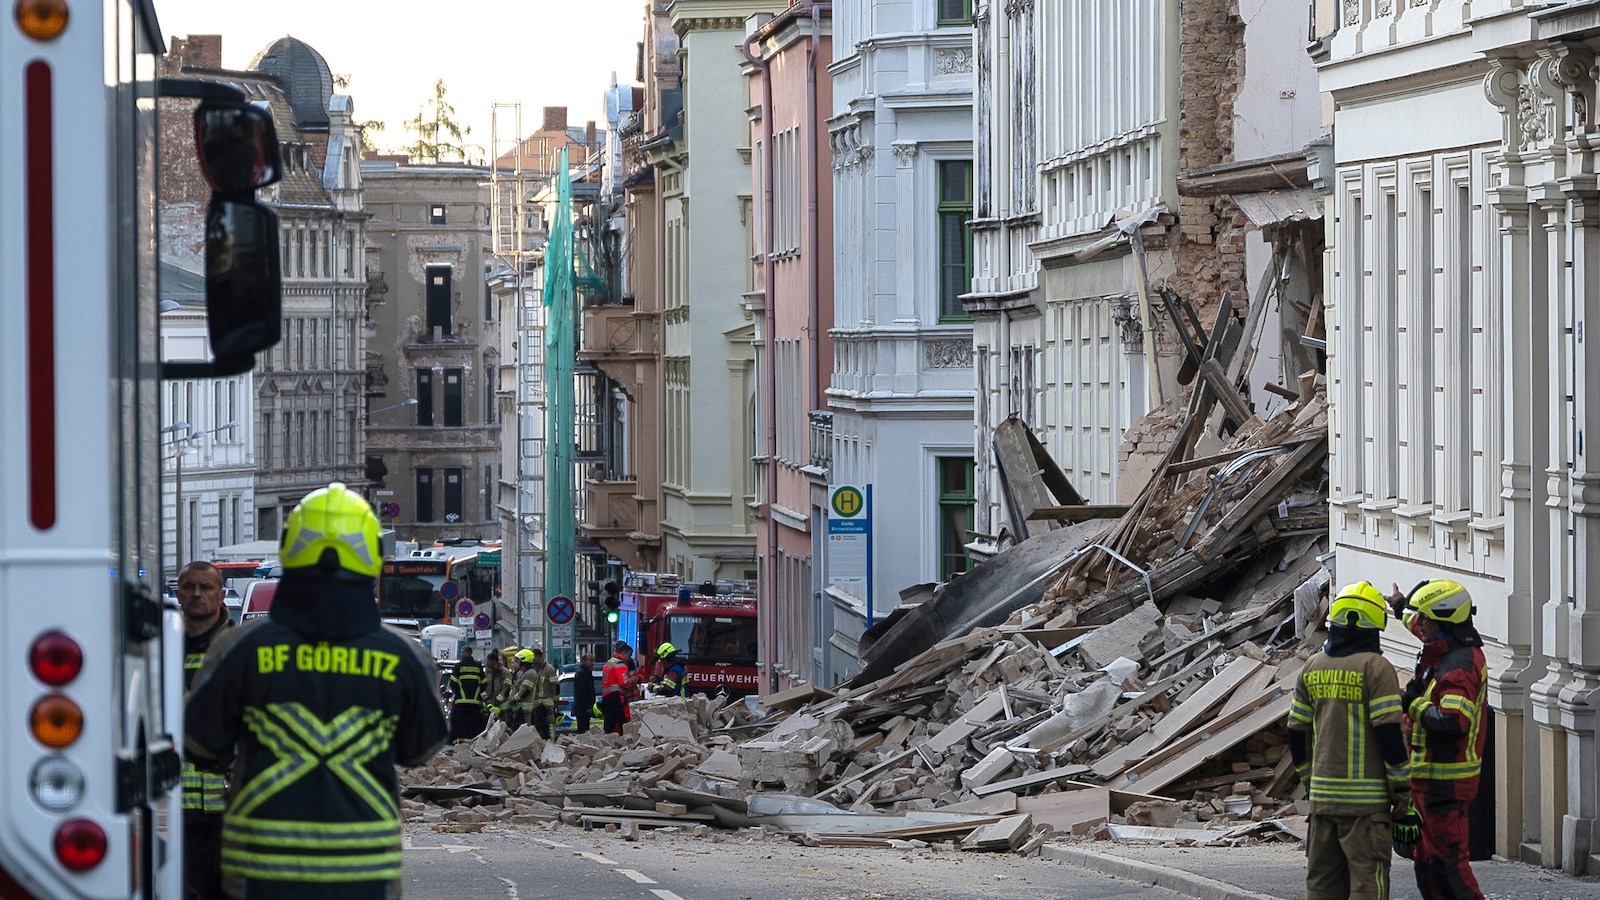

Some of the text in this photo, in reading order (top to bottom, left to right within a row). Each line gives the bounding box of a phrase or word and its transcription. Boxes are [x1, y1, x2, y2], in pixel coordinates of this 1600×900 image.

[257, 640, 400, 682] BF GÖRLITZ
[687, 673, 759, 684] FEUERWEHR
